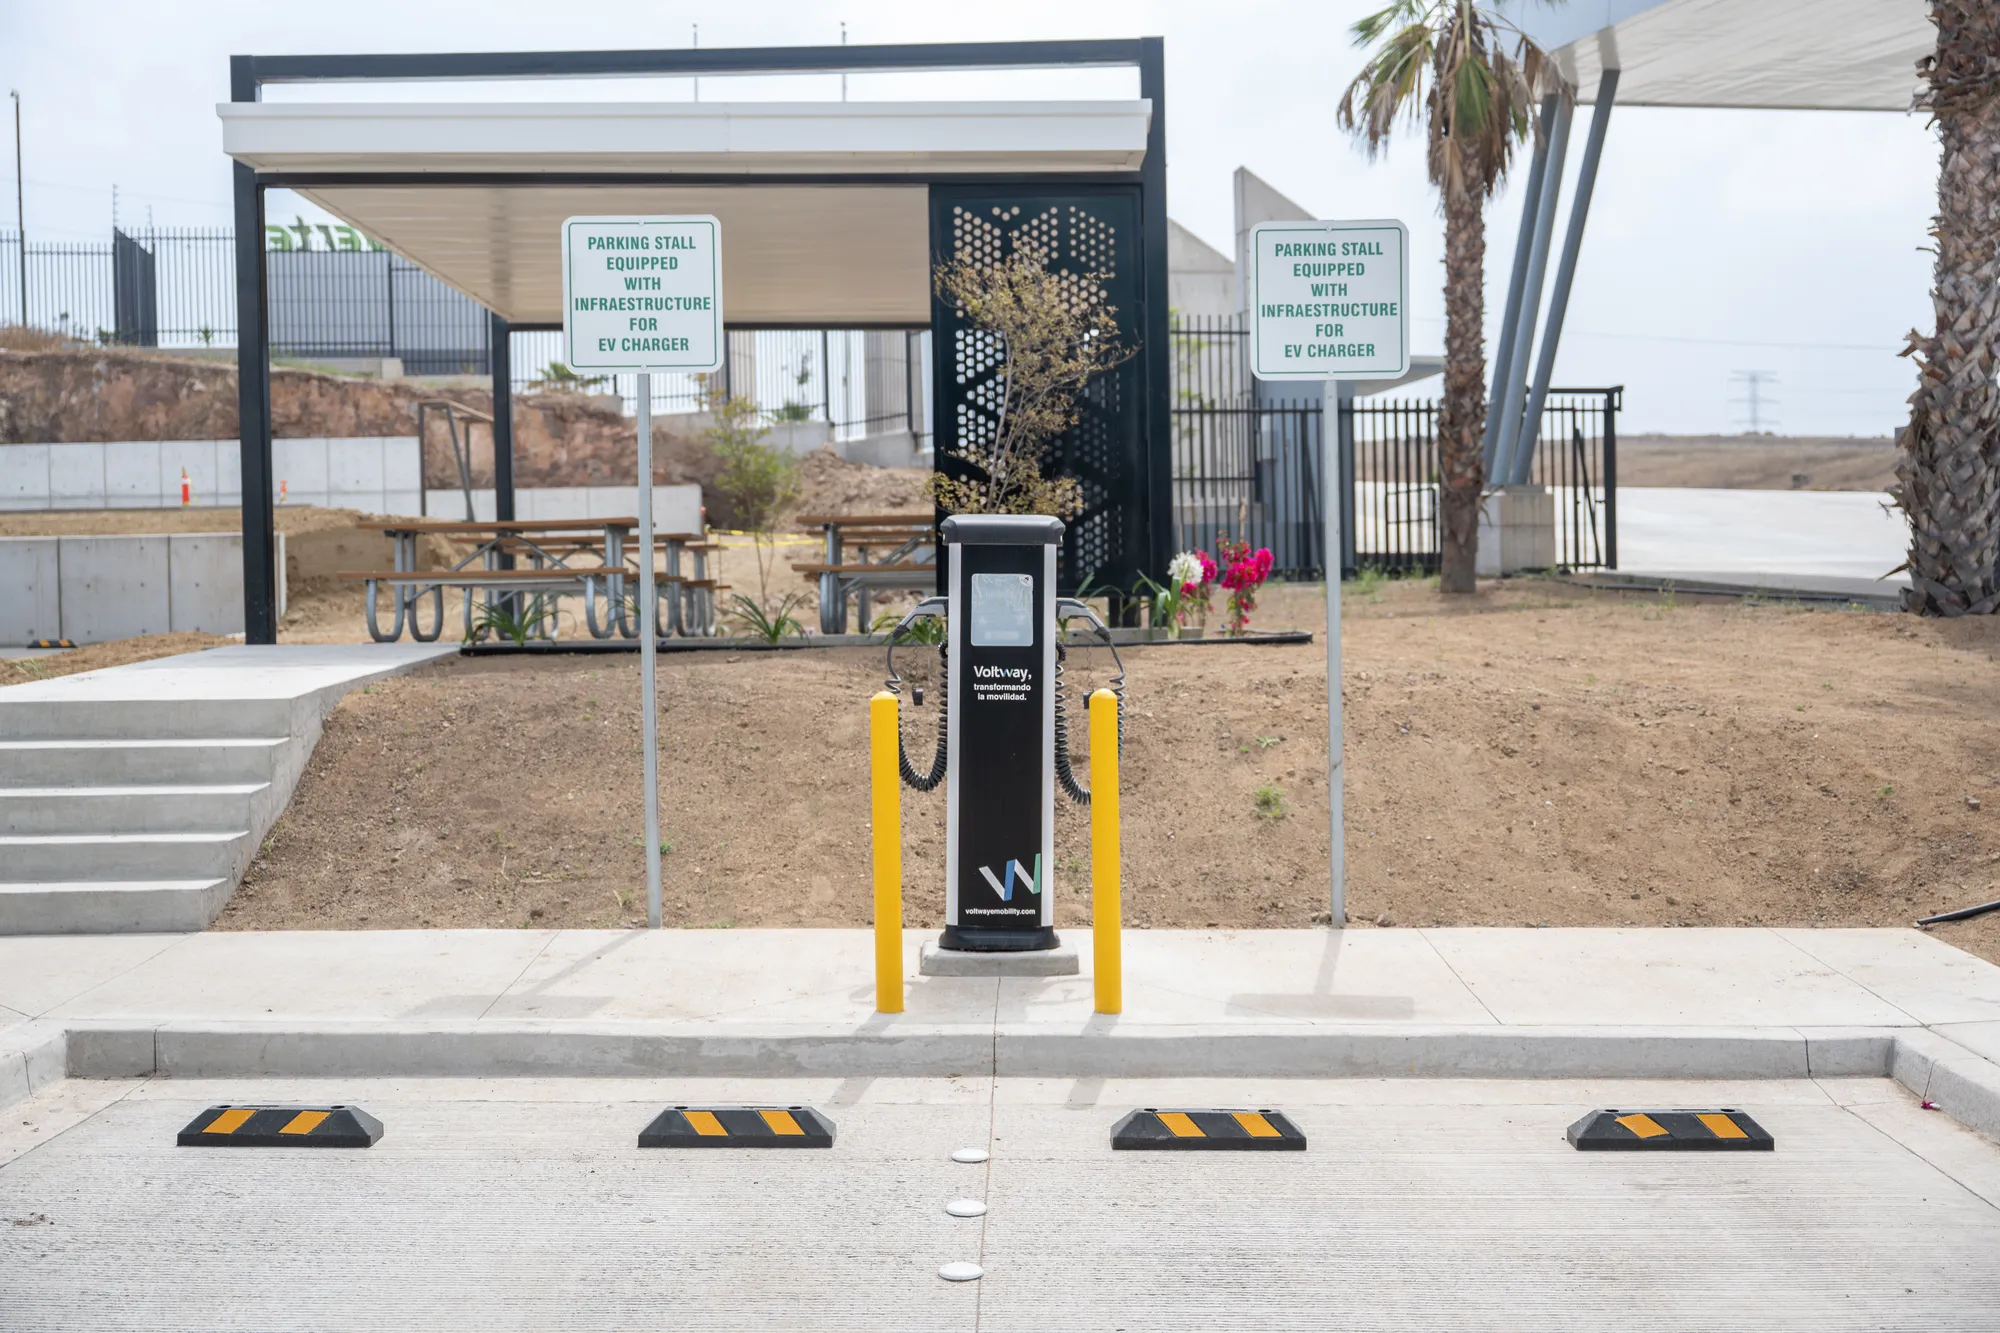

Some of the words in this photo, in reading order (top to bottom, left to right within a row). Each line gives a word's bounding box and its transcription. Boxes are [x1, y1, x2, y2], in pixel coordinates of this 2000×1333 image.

[587, 235, 650, 251] PARKING
[654, 235, 697, 251] STALL
[1274, 241, 1337, 258] PARKING
[1341, 241, 1384, 257] STALL
[606, 256, 679, 272] EQUIPPED
[1293, 262, 1366, 279] EQUIPPED
[623, 276, 661, 291] WITH
[1310, 282, 1348, 297] WITH
[574, 296, 711, 312] INFRAESTRUCTURE
[1261, 302, 1398, 318] INFRAESTRUCTURE
[629, 317, 658, 332] FOR
[1315, 323, 1344, 338] FOR
[598, 337, 617, 352] EV
[621, 337, 690, 352] CHARGER
[1284, 343, 1303, 358] EV
[1307, 343, 1376, 358] CHARGER
[974, 666, 1031, 681] Voltway,
[973, 682, 1032, 692] transformando
[977, 692, 986, 701] la
[986, 692, 1027, 701] movilidad.
[964, 907, 1036, 917] voltwayemobility.com
